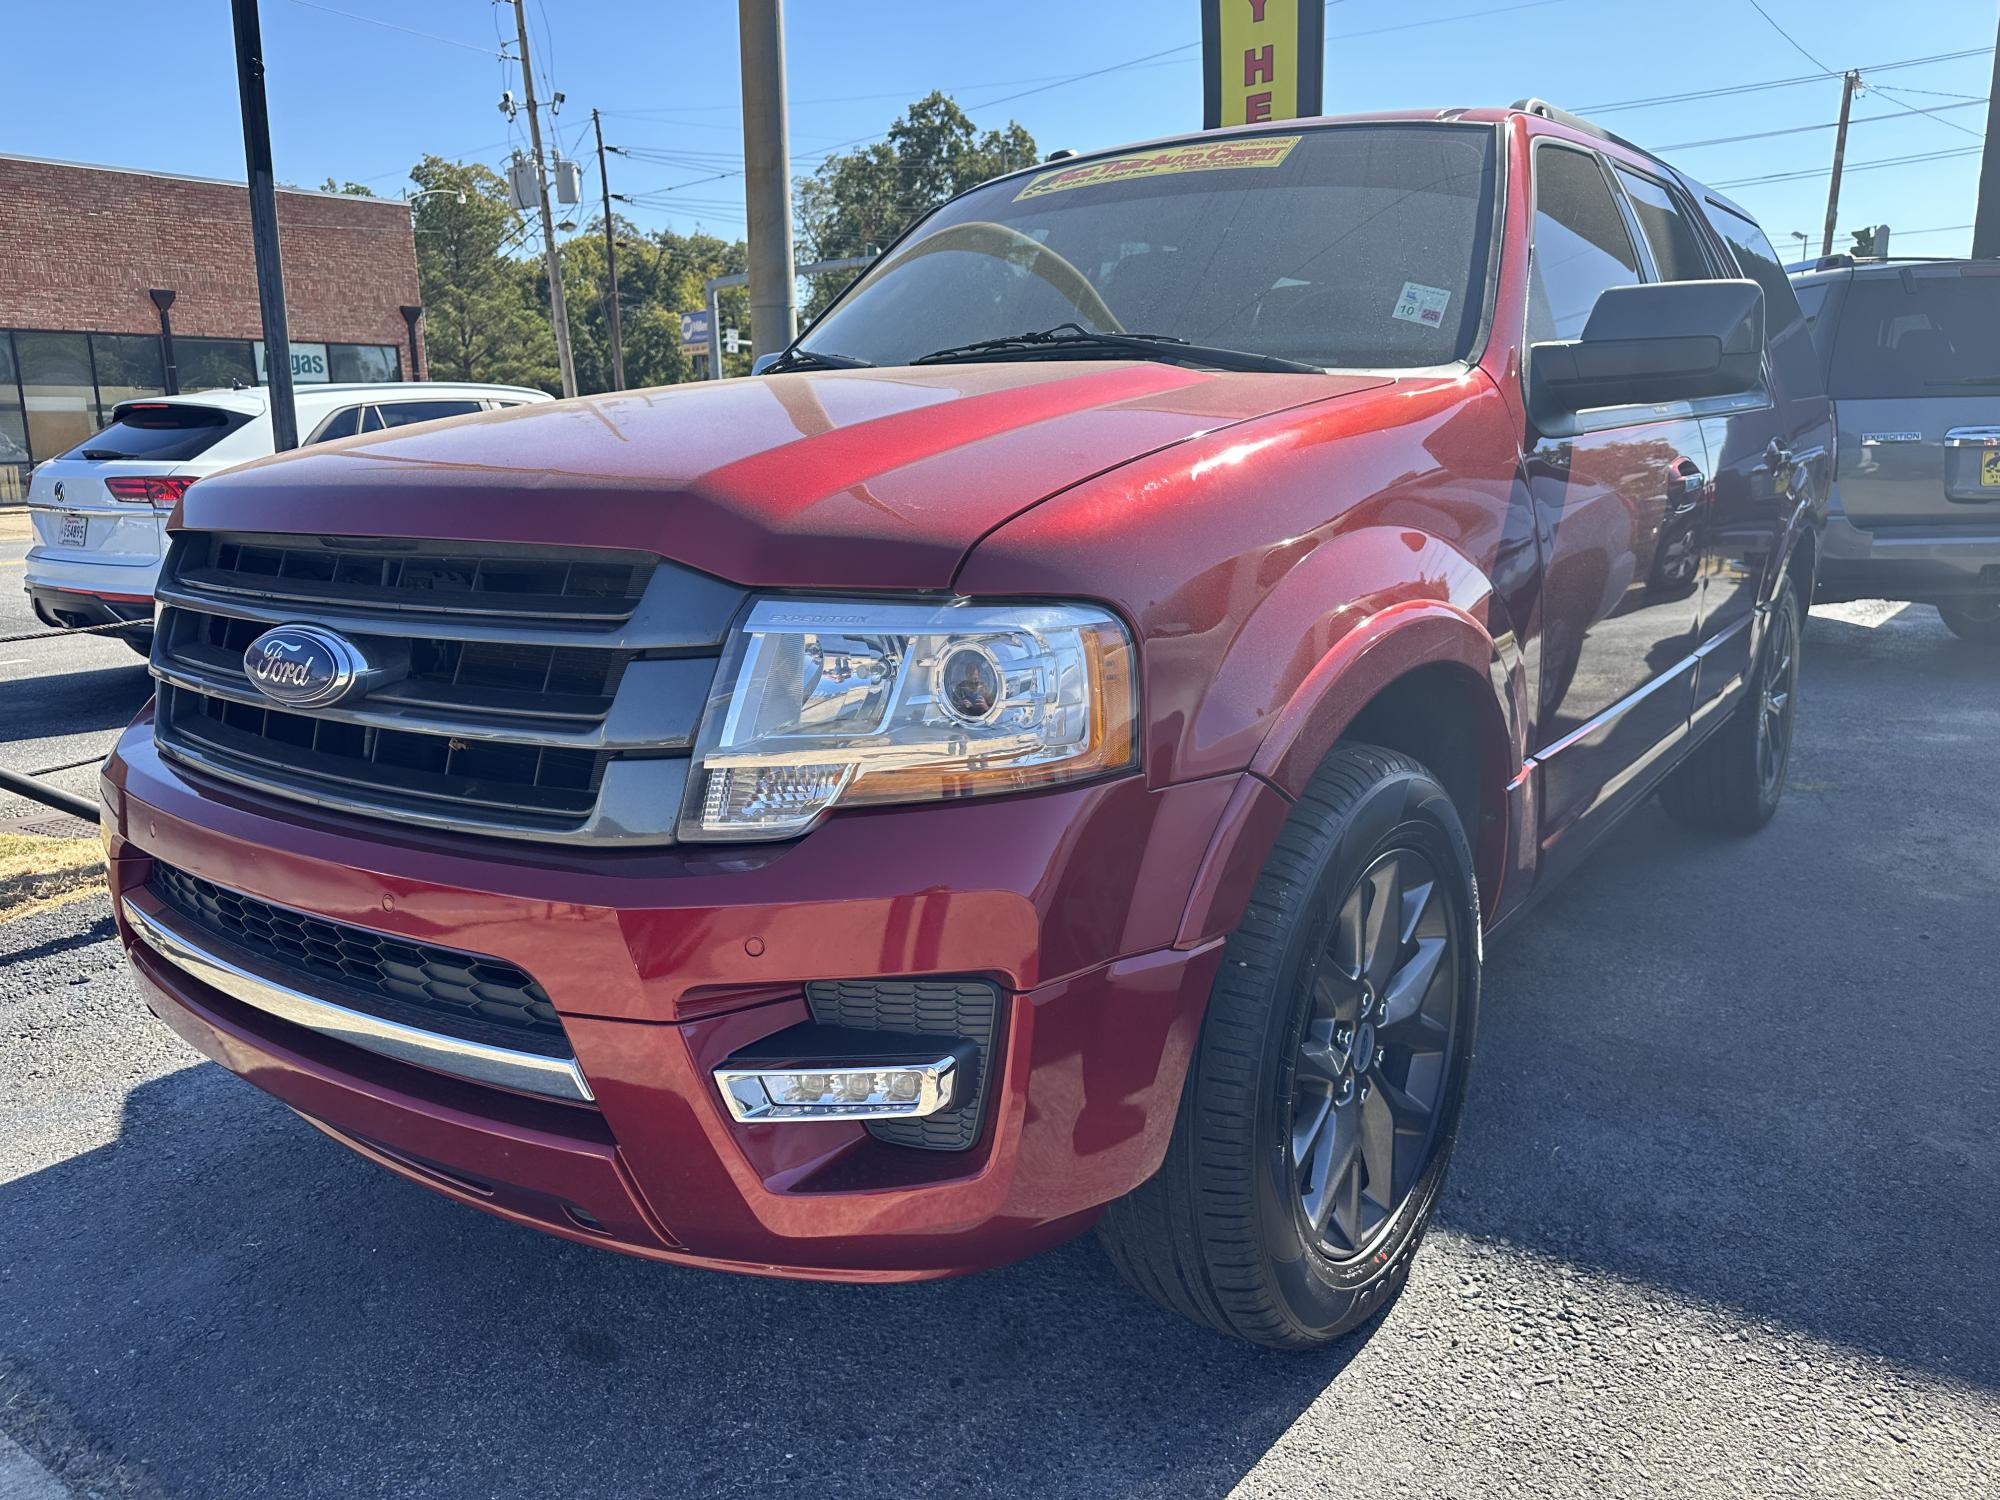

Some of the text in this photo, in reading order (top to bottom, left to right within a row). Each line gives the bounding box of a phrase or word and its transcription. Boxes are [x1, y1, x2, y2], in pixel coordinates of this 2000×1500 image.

[1400, 304, 1415, 316] 10
[1863, 433, 1921, 441] EXPEDITION
[769, 613, 869, 625] EXPEDITION
[256, 639, 314, 687] Ford
